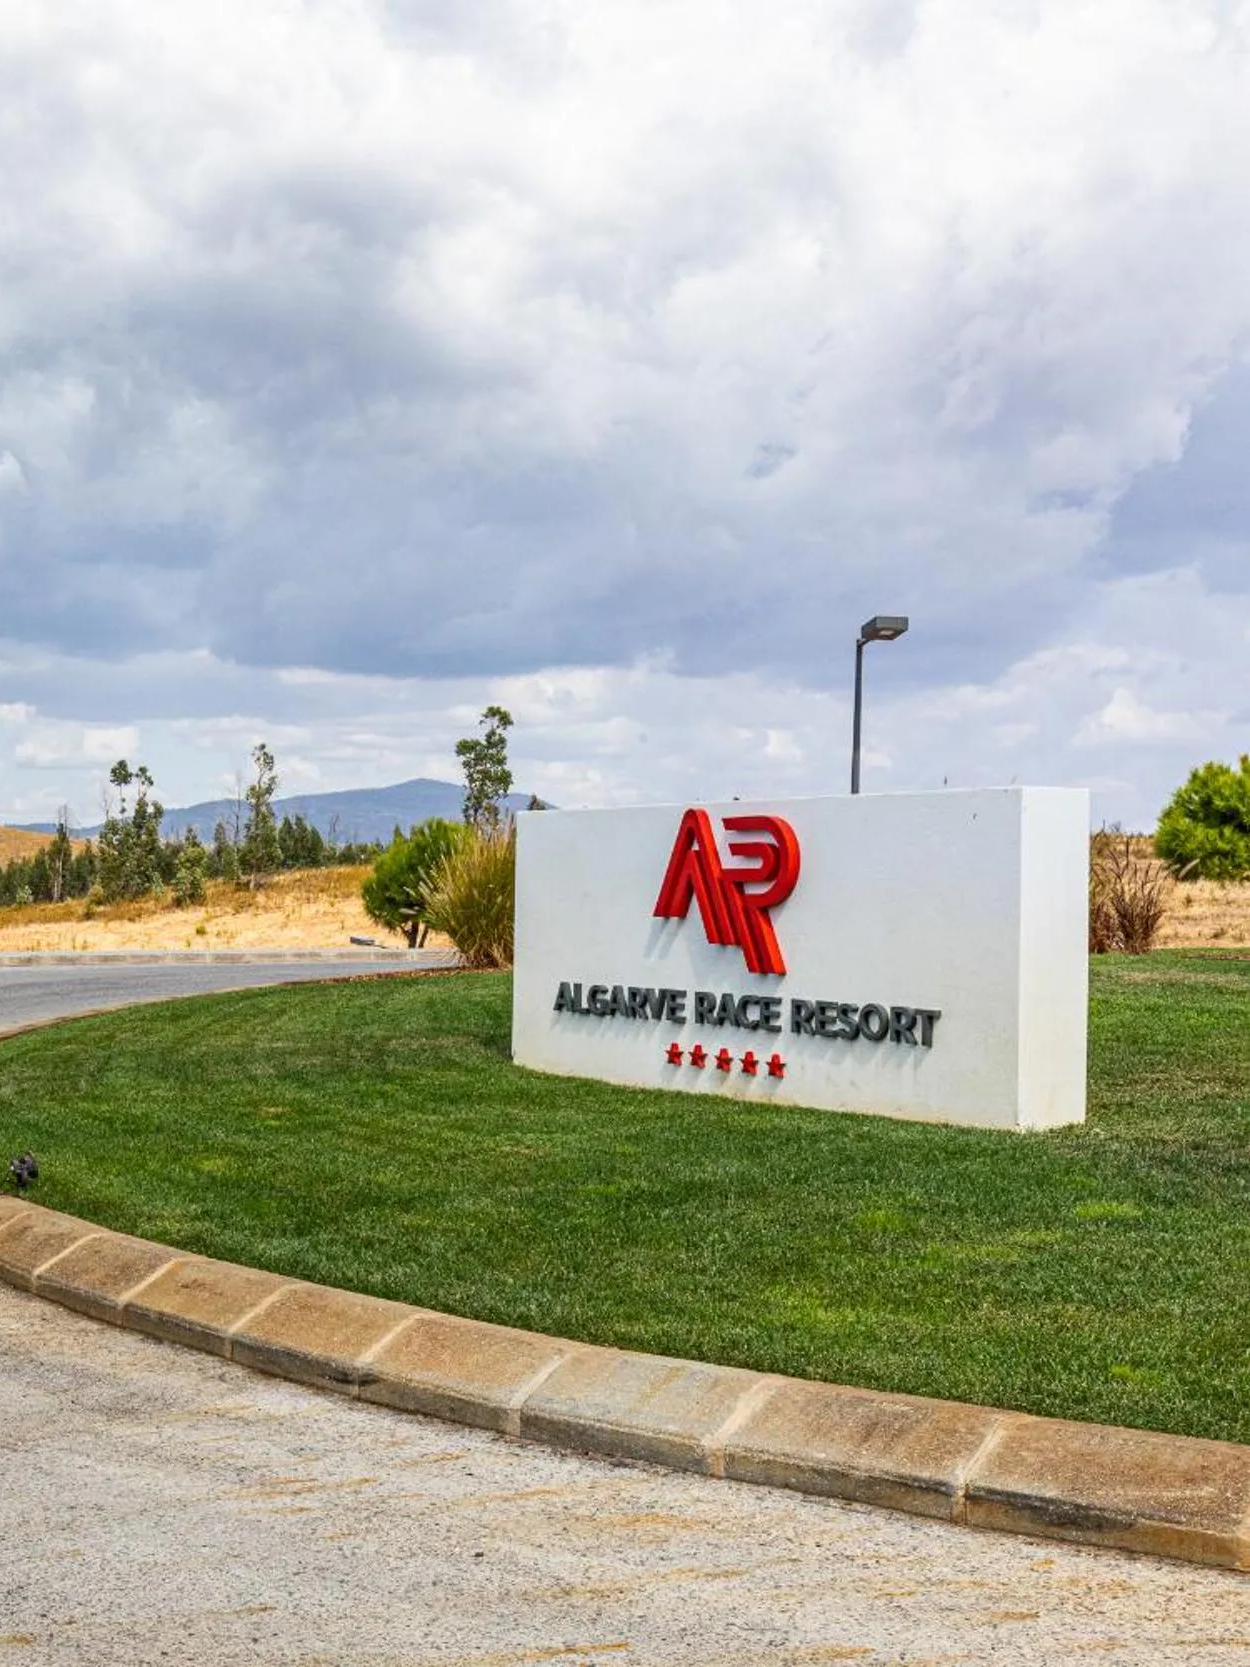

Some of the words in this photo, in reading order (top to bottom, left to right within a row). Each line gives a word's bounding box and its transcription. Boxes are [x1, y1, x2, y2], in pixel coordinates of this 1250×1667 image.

[553, 981, 688, 1025] ALGARVE
[694, 991, 783, 1033] RACE
[791, 998, 942, 1049] RESORT
